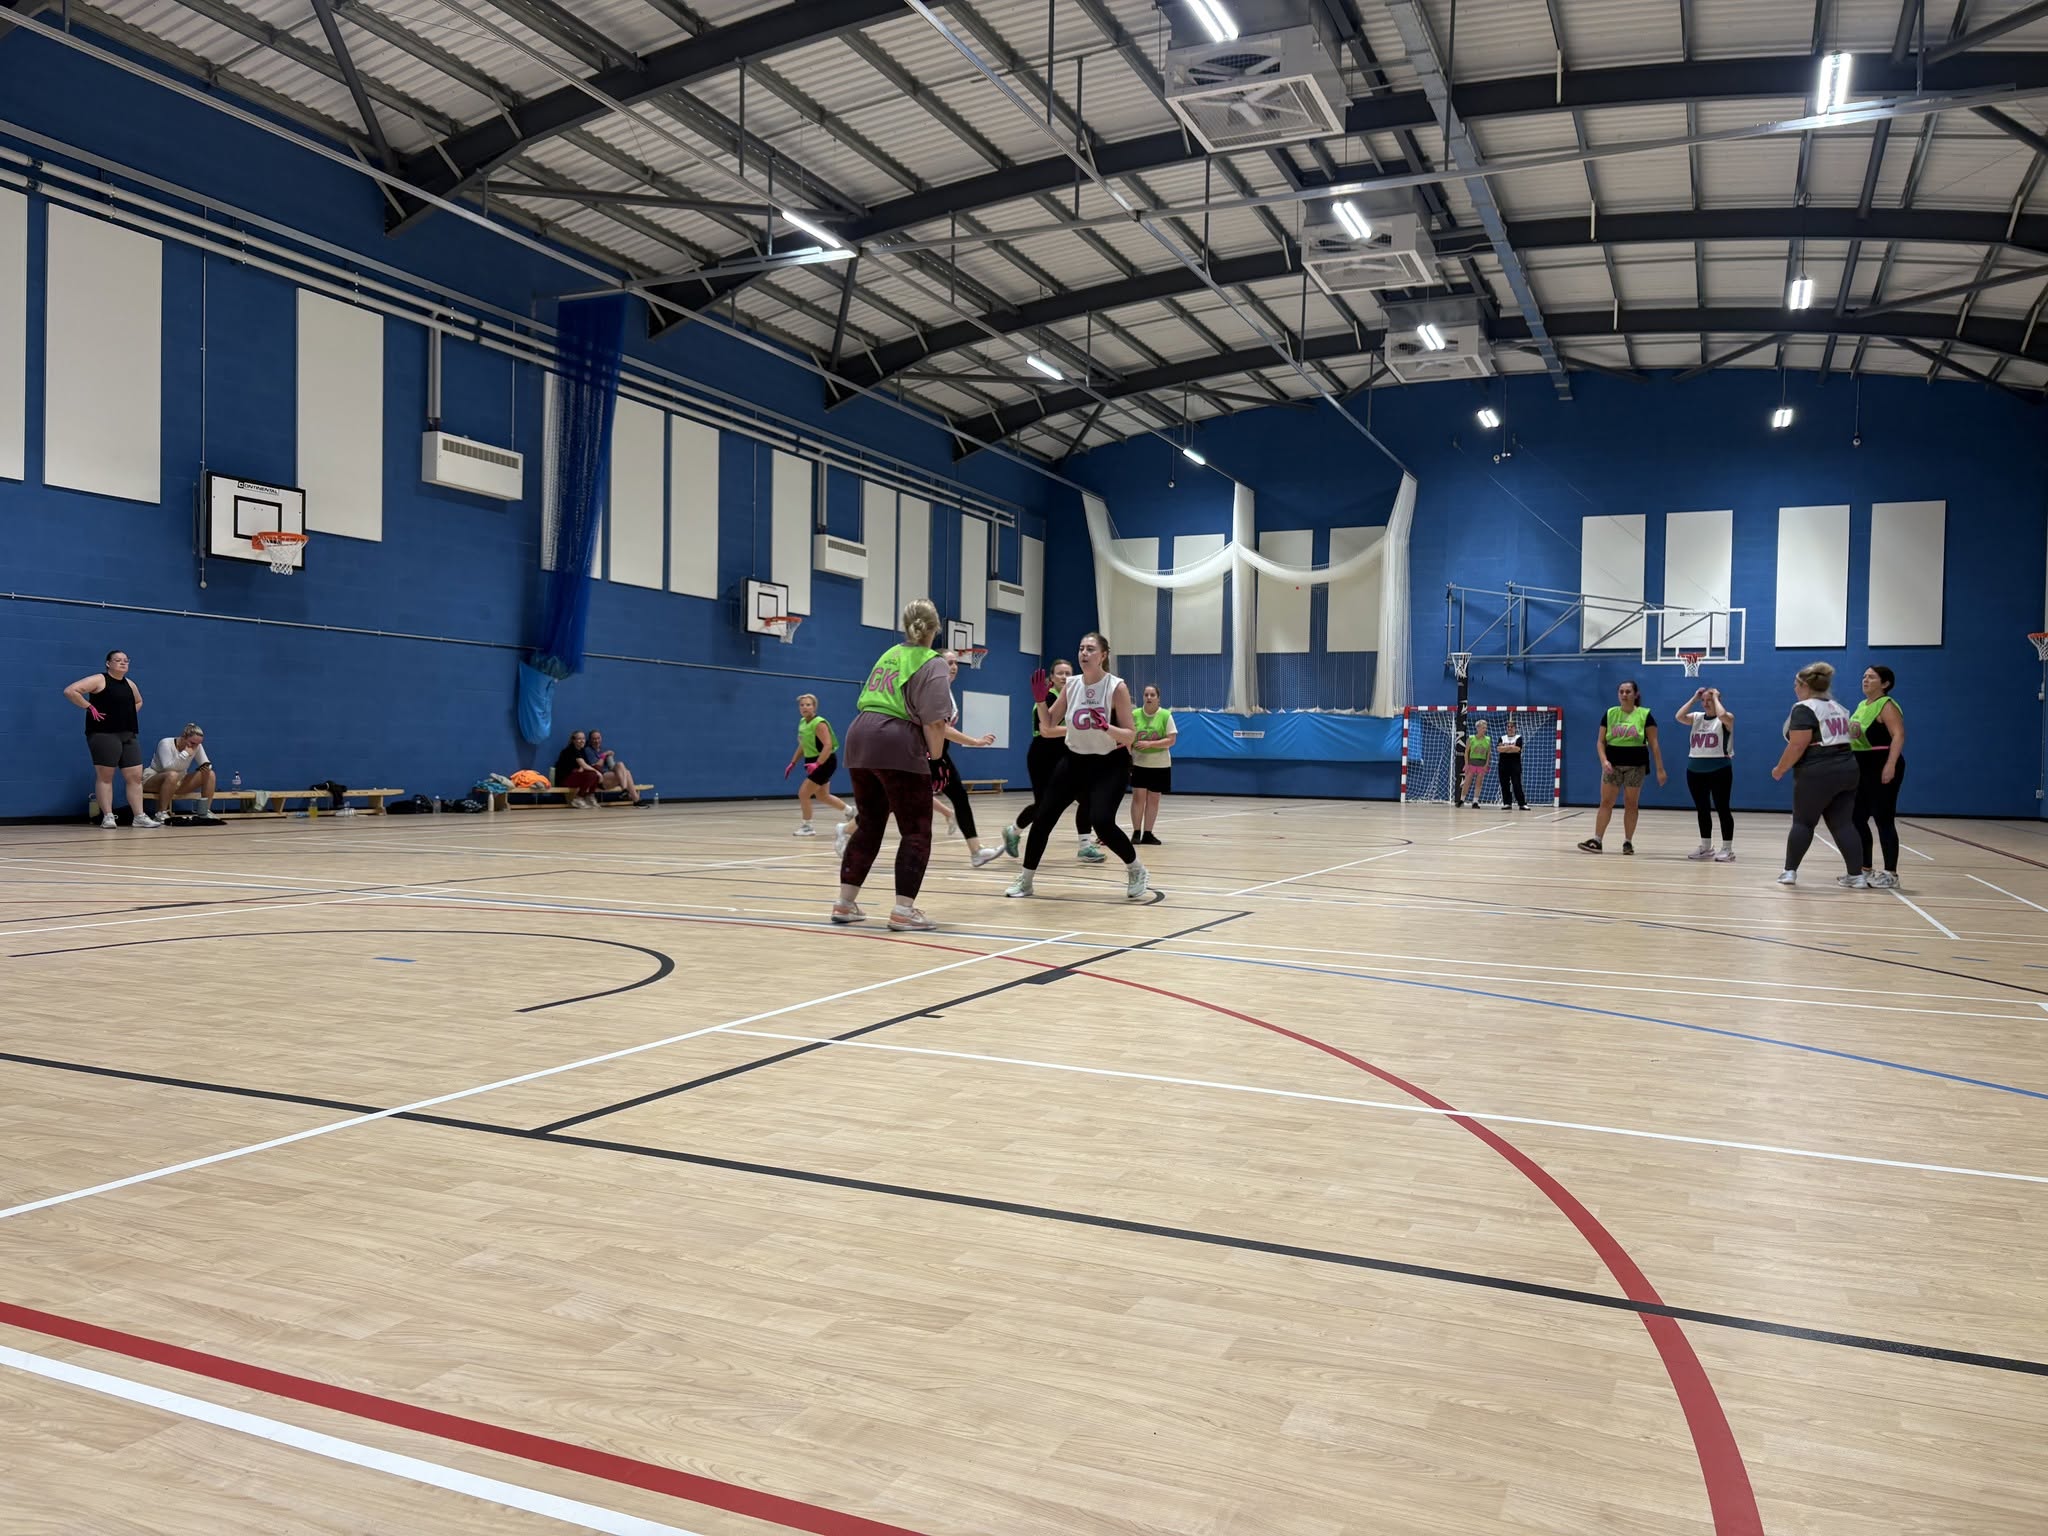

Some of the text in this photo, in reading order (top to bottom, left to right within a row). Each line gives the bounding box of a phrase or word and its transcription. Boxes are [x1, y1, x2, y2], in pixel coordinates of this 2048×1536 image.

[238, 481, 278, 495] CONTINENTAL
[868, 667, 899, 695] GK
[1612, 725, 1638, 738] WA
[1691, 733, 1718, 749] WD
